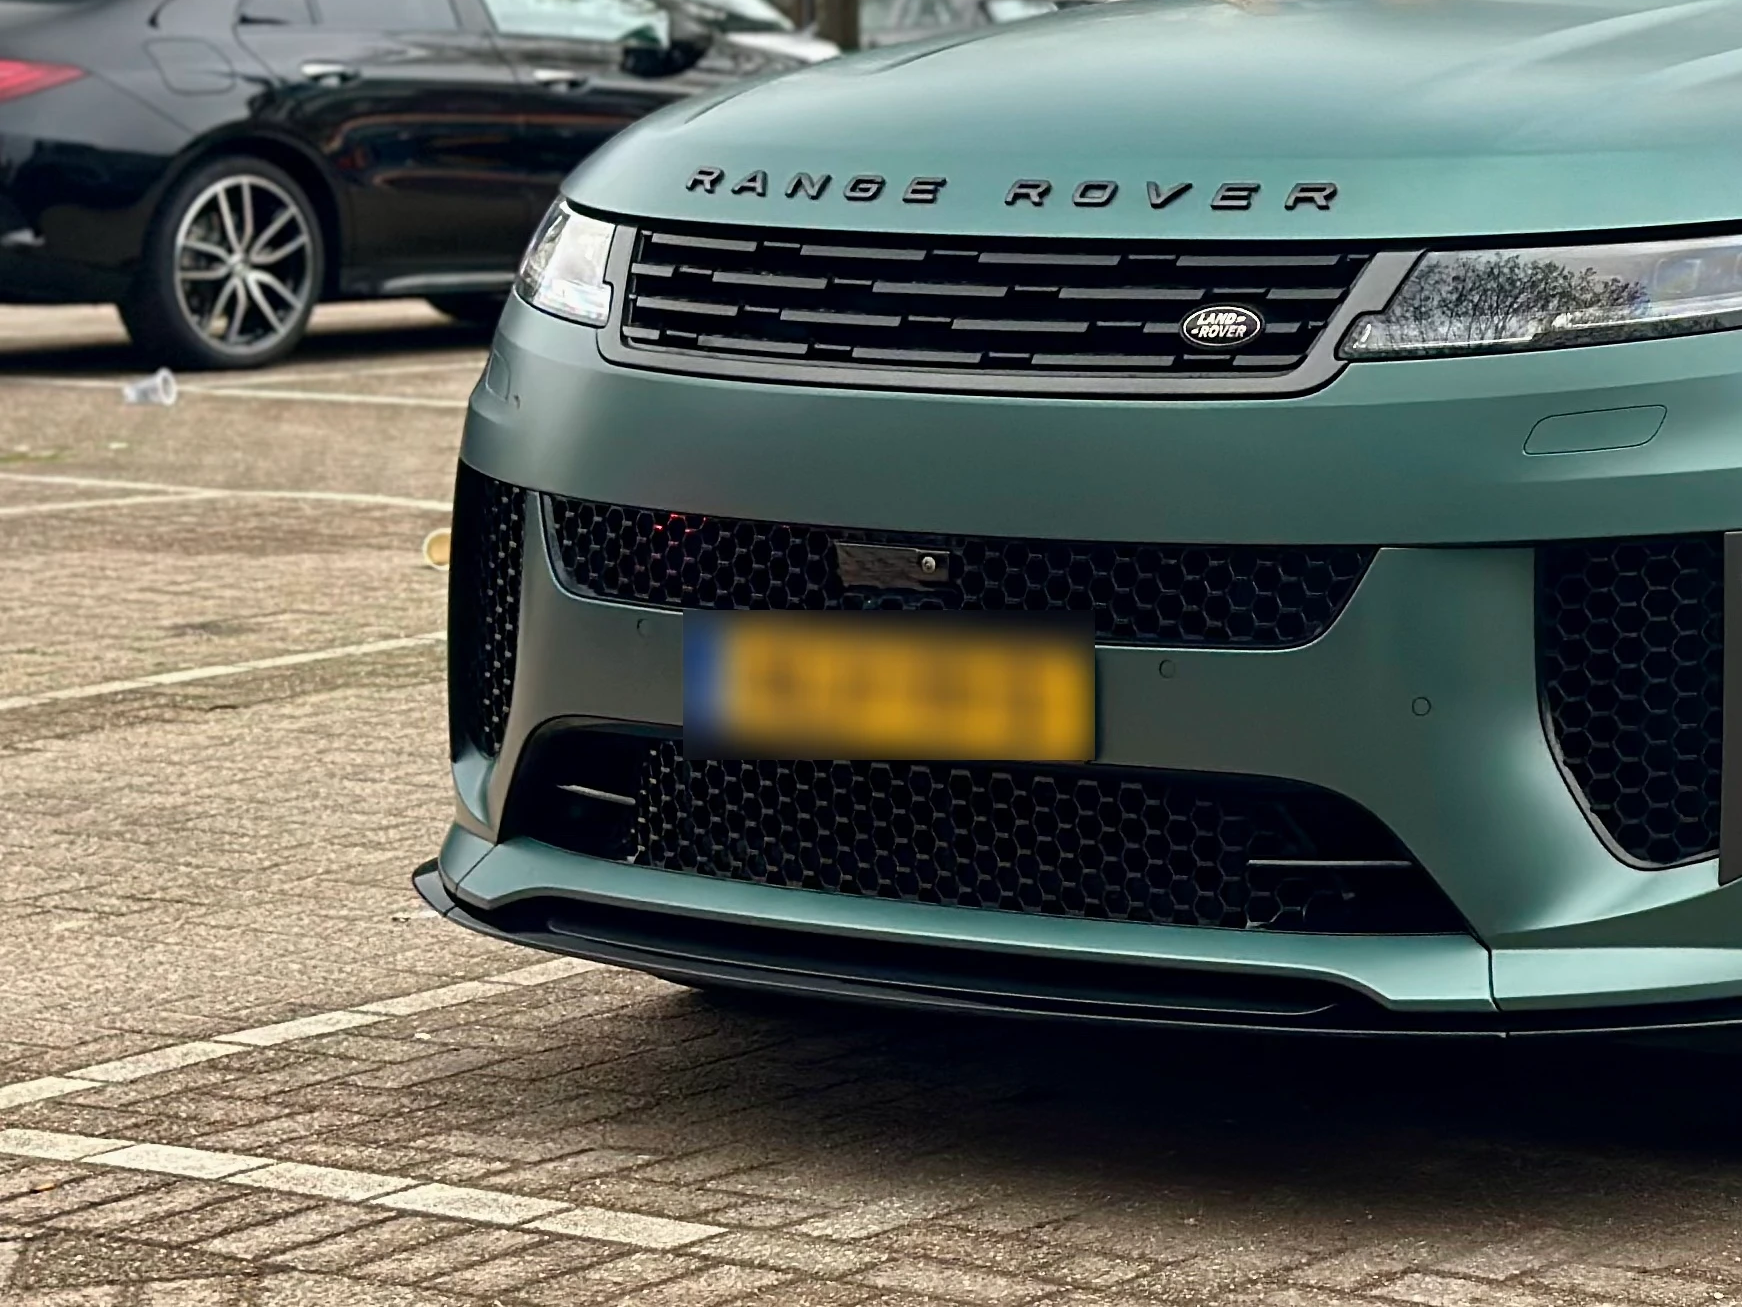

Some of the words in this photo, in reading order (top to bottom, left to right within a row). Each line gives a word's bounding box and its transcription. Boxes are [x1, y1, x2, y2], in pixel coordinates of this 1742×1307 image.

[686, 165, 947, 206] RANGE
[1004, 178, 1340, 212] ROVER
[1197, 312, 1238, 325] LAND
[1198, 324, 1247, 338] ROVER
